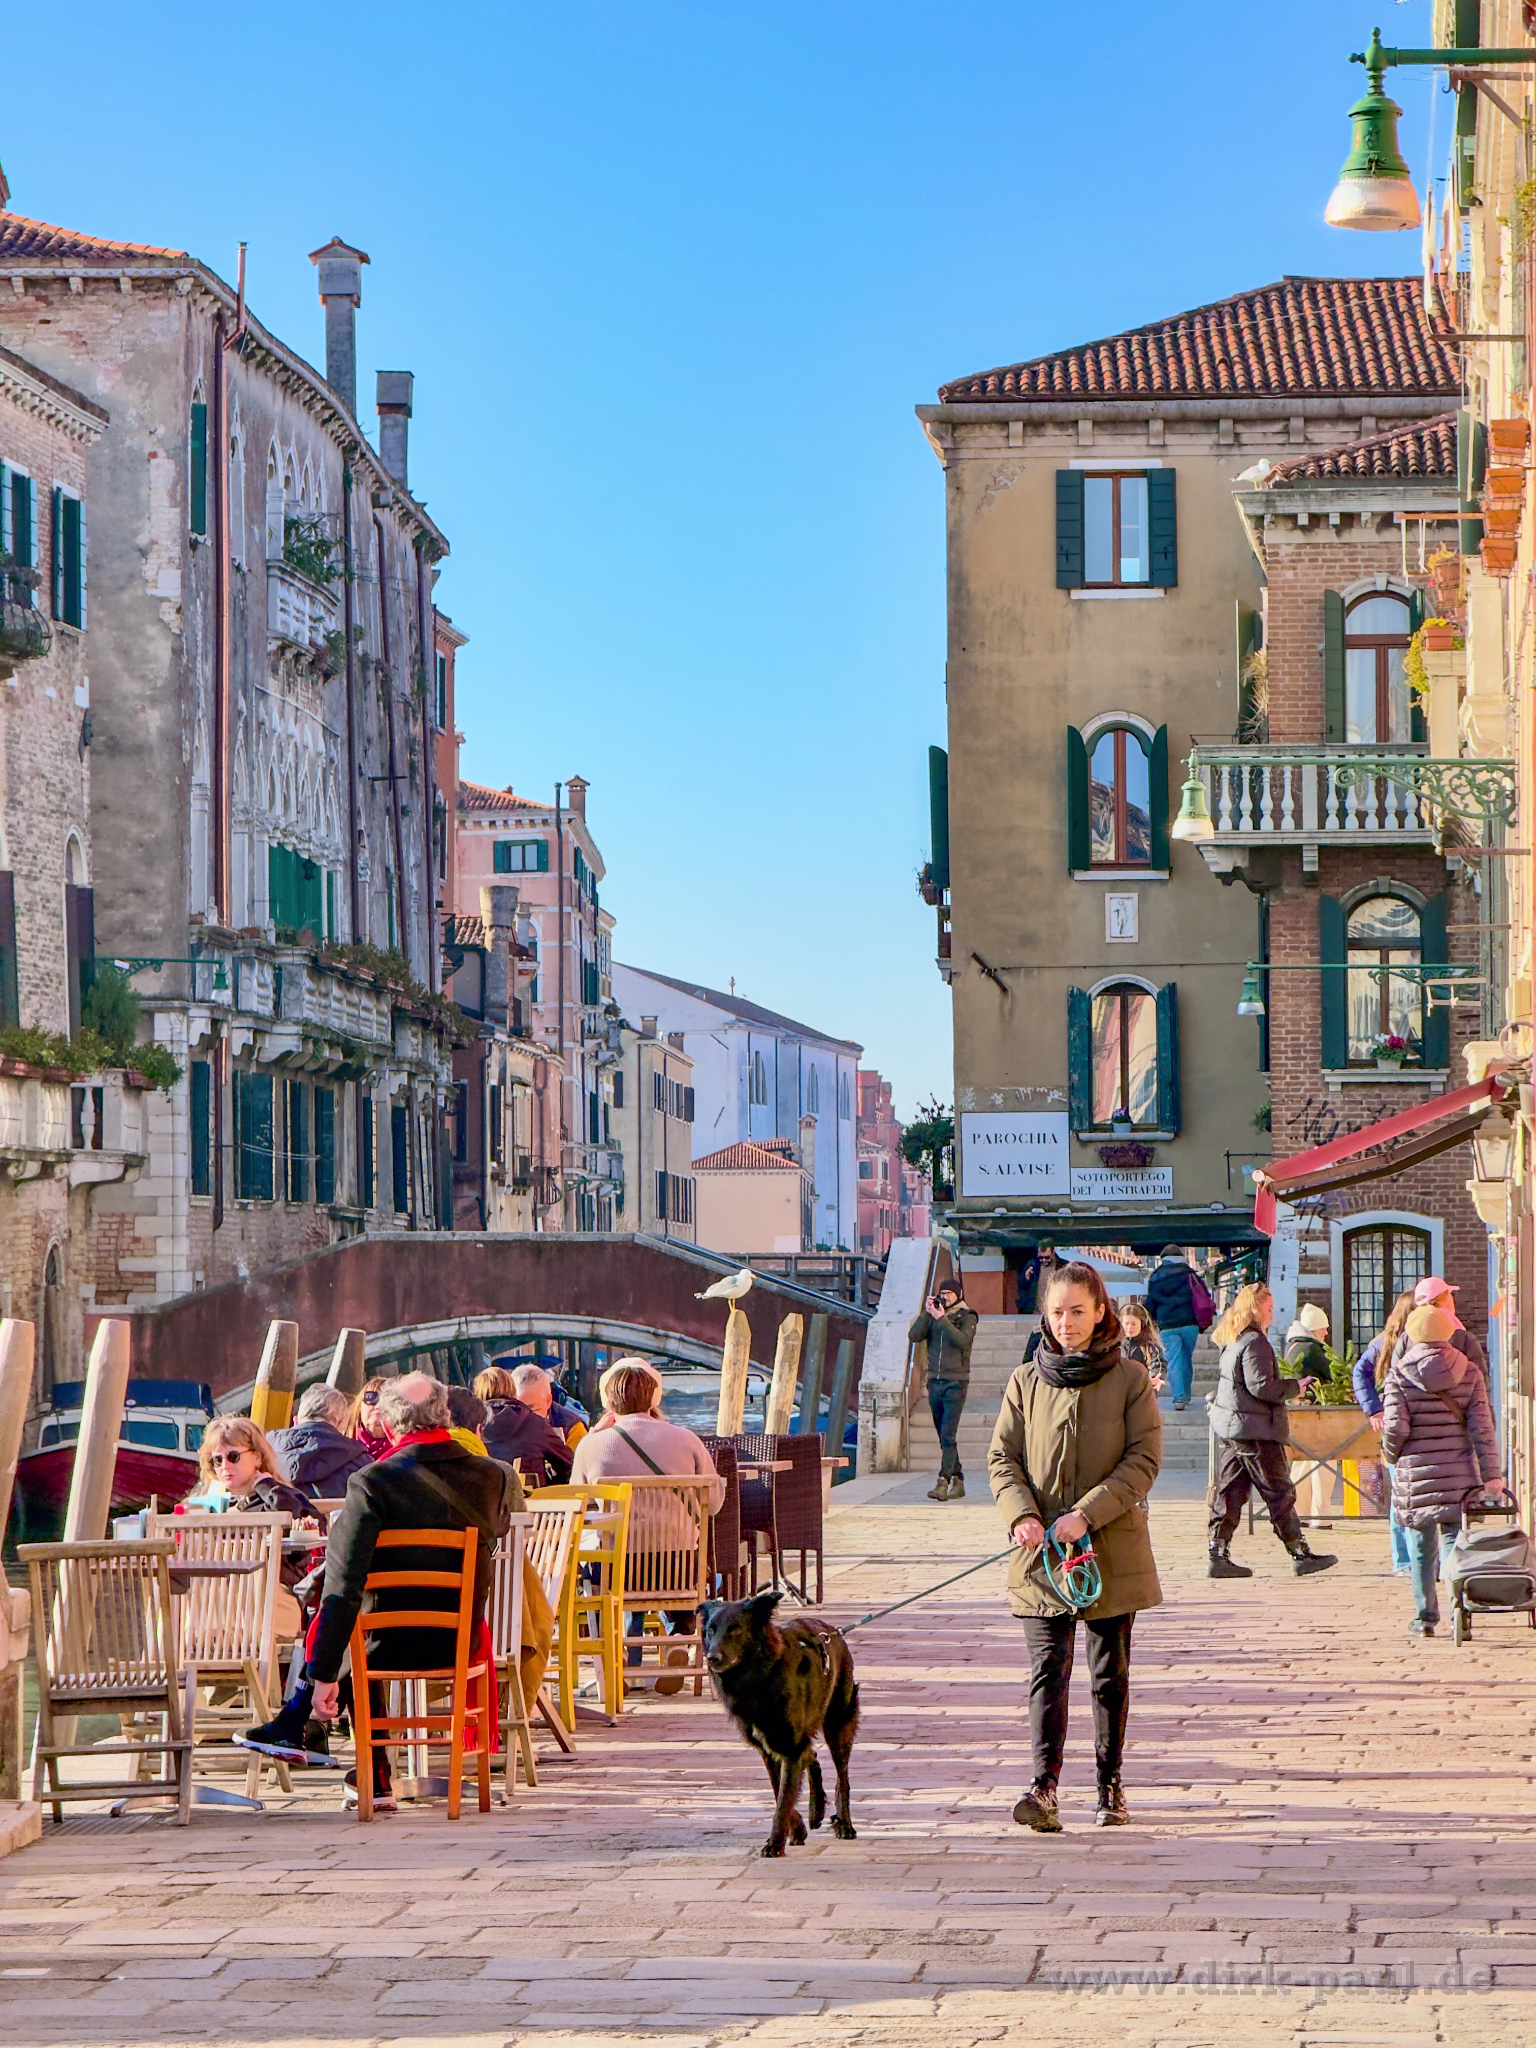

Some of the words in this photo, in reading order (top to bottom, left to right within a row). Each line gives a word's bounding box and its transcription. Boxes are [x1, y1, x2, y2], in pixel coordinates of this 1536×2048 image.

[972, 1132, 1058, 1145] PAROCHIA
[994, 1163, 1055, 1175] ALVISE
[1077, 1172, 1165, 1182] SOTOPORTEGO
[1103, 1185, 1171, 1196] LUSTRAFERI
